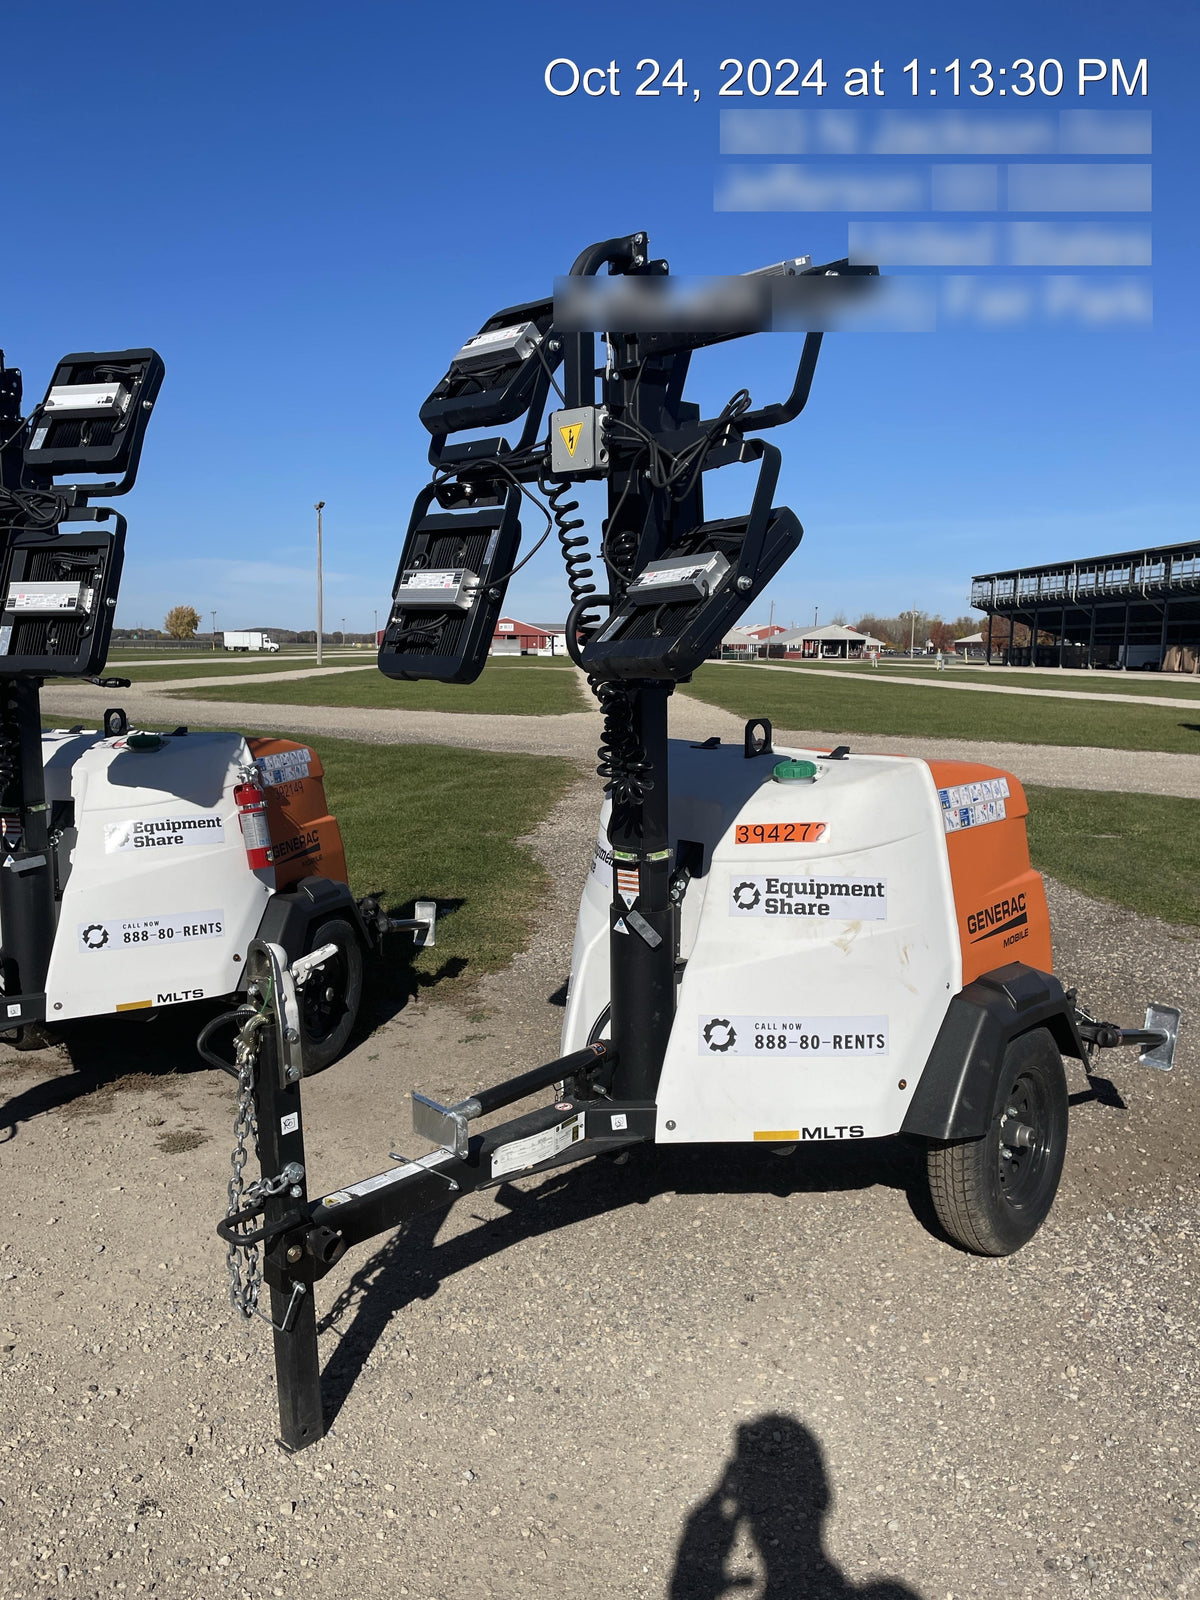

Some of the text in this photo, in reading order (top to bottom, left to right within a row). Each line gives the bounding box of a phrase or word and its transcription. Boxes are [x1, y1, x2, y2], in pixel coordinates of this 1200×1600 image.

[133, 816, 222, 834] Equipment
[737, 823, 827, 844] 394272
[133, 833, 184, 848] Share
[272, 829, 320, 860] GENERAC
[765, 878, 885, 899] Equipment
[764, 898, 830, 916] Share
[966, 893, 1027, 935] GENERAC
[122, 920, 160, 930] CALL NOW
[123, 921, 223, 944] 888-80-RENTS
[1003, 927, 1029, 949] MOBILE
[157, 988, 204, 1003] MLTS
[754, 1022, 803, 1031] CALL NOW
[754, 1033, 886, 1050] 888-80-RENTS
[801, 1125, 865, 1140] MLTS
